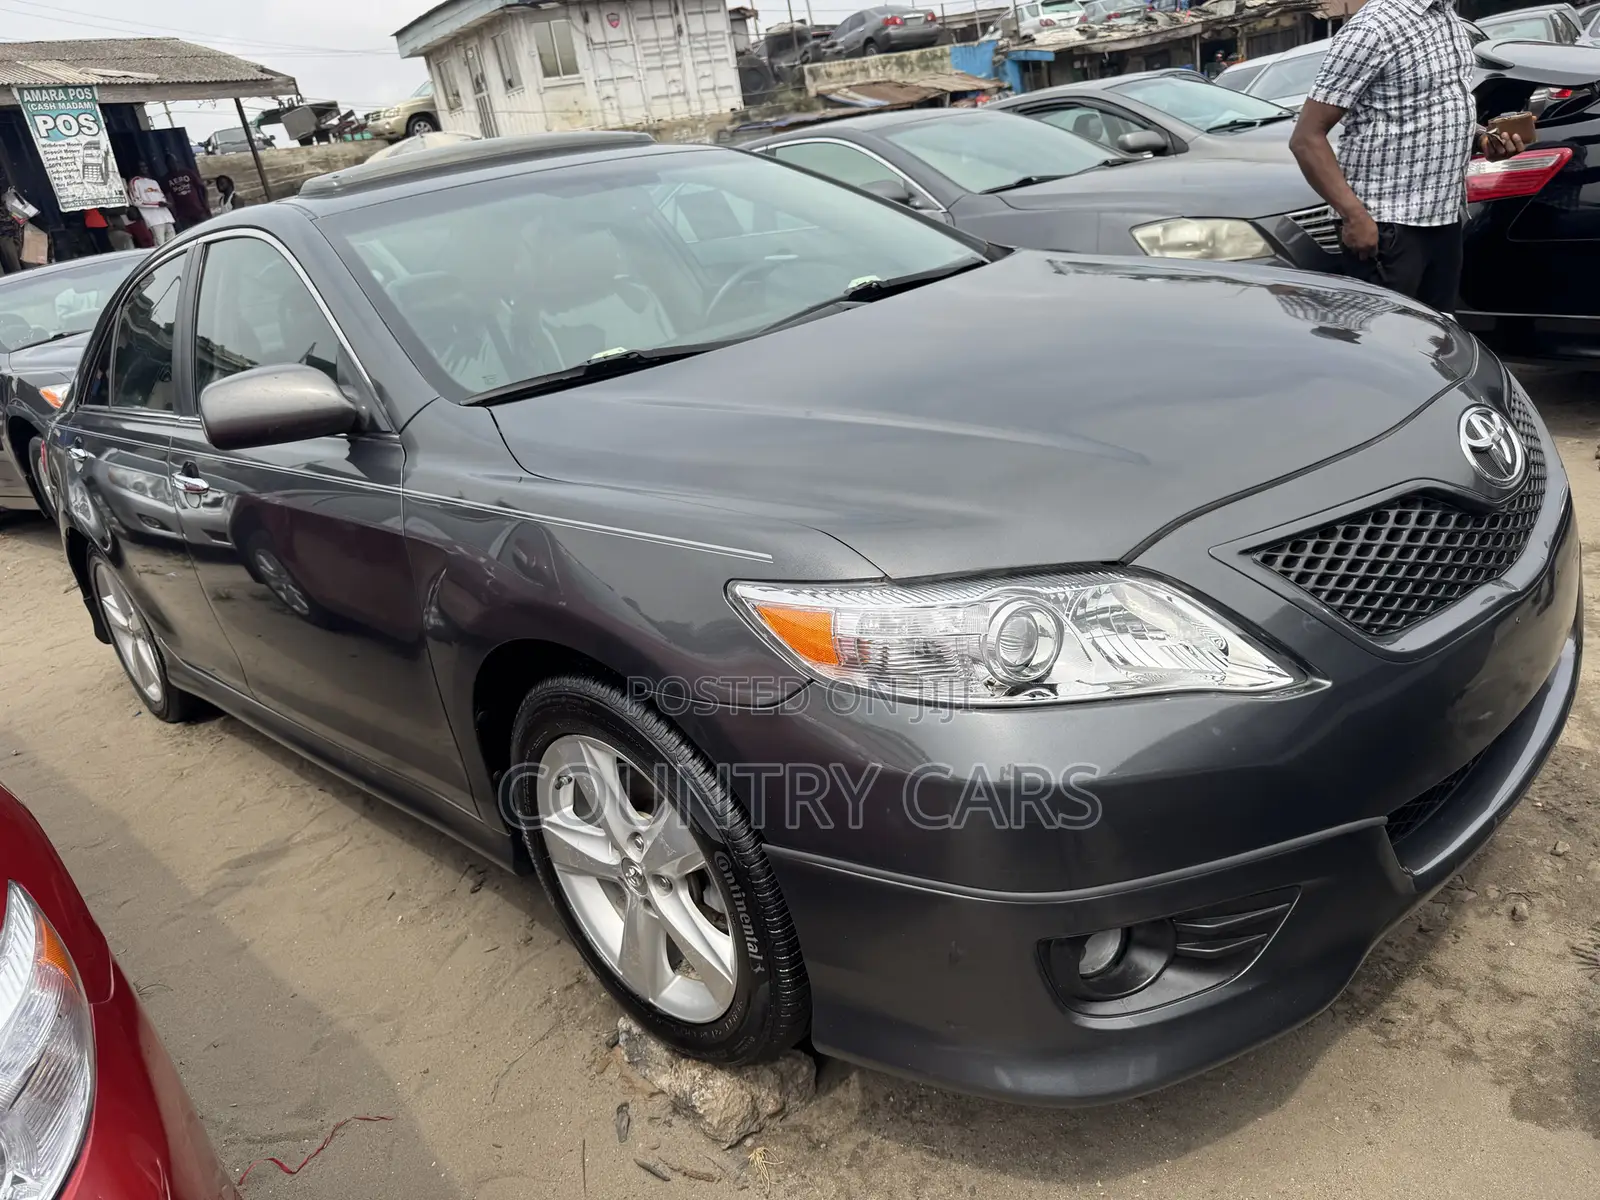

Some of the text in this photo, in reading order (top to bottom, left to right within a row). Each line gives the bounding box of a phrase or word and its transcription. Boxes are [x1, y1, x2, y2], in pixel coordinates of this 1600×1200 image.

[23, 87, 93, 102] AMARA POS
[27, 101, 95, 112] (CASH MADAM)
[33, 113, 99, 138] POS
[713, 850, 765, 962] Continental
